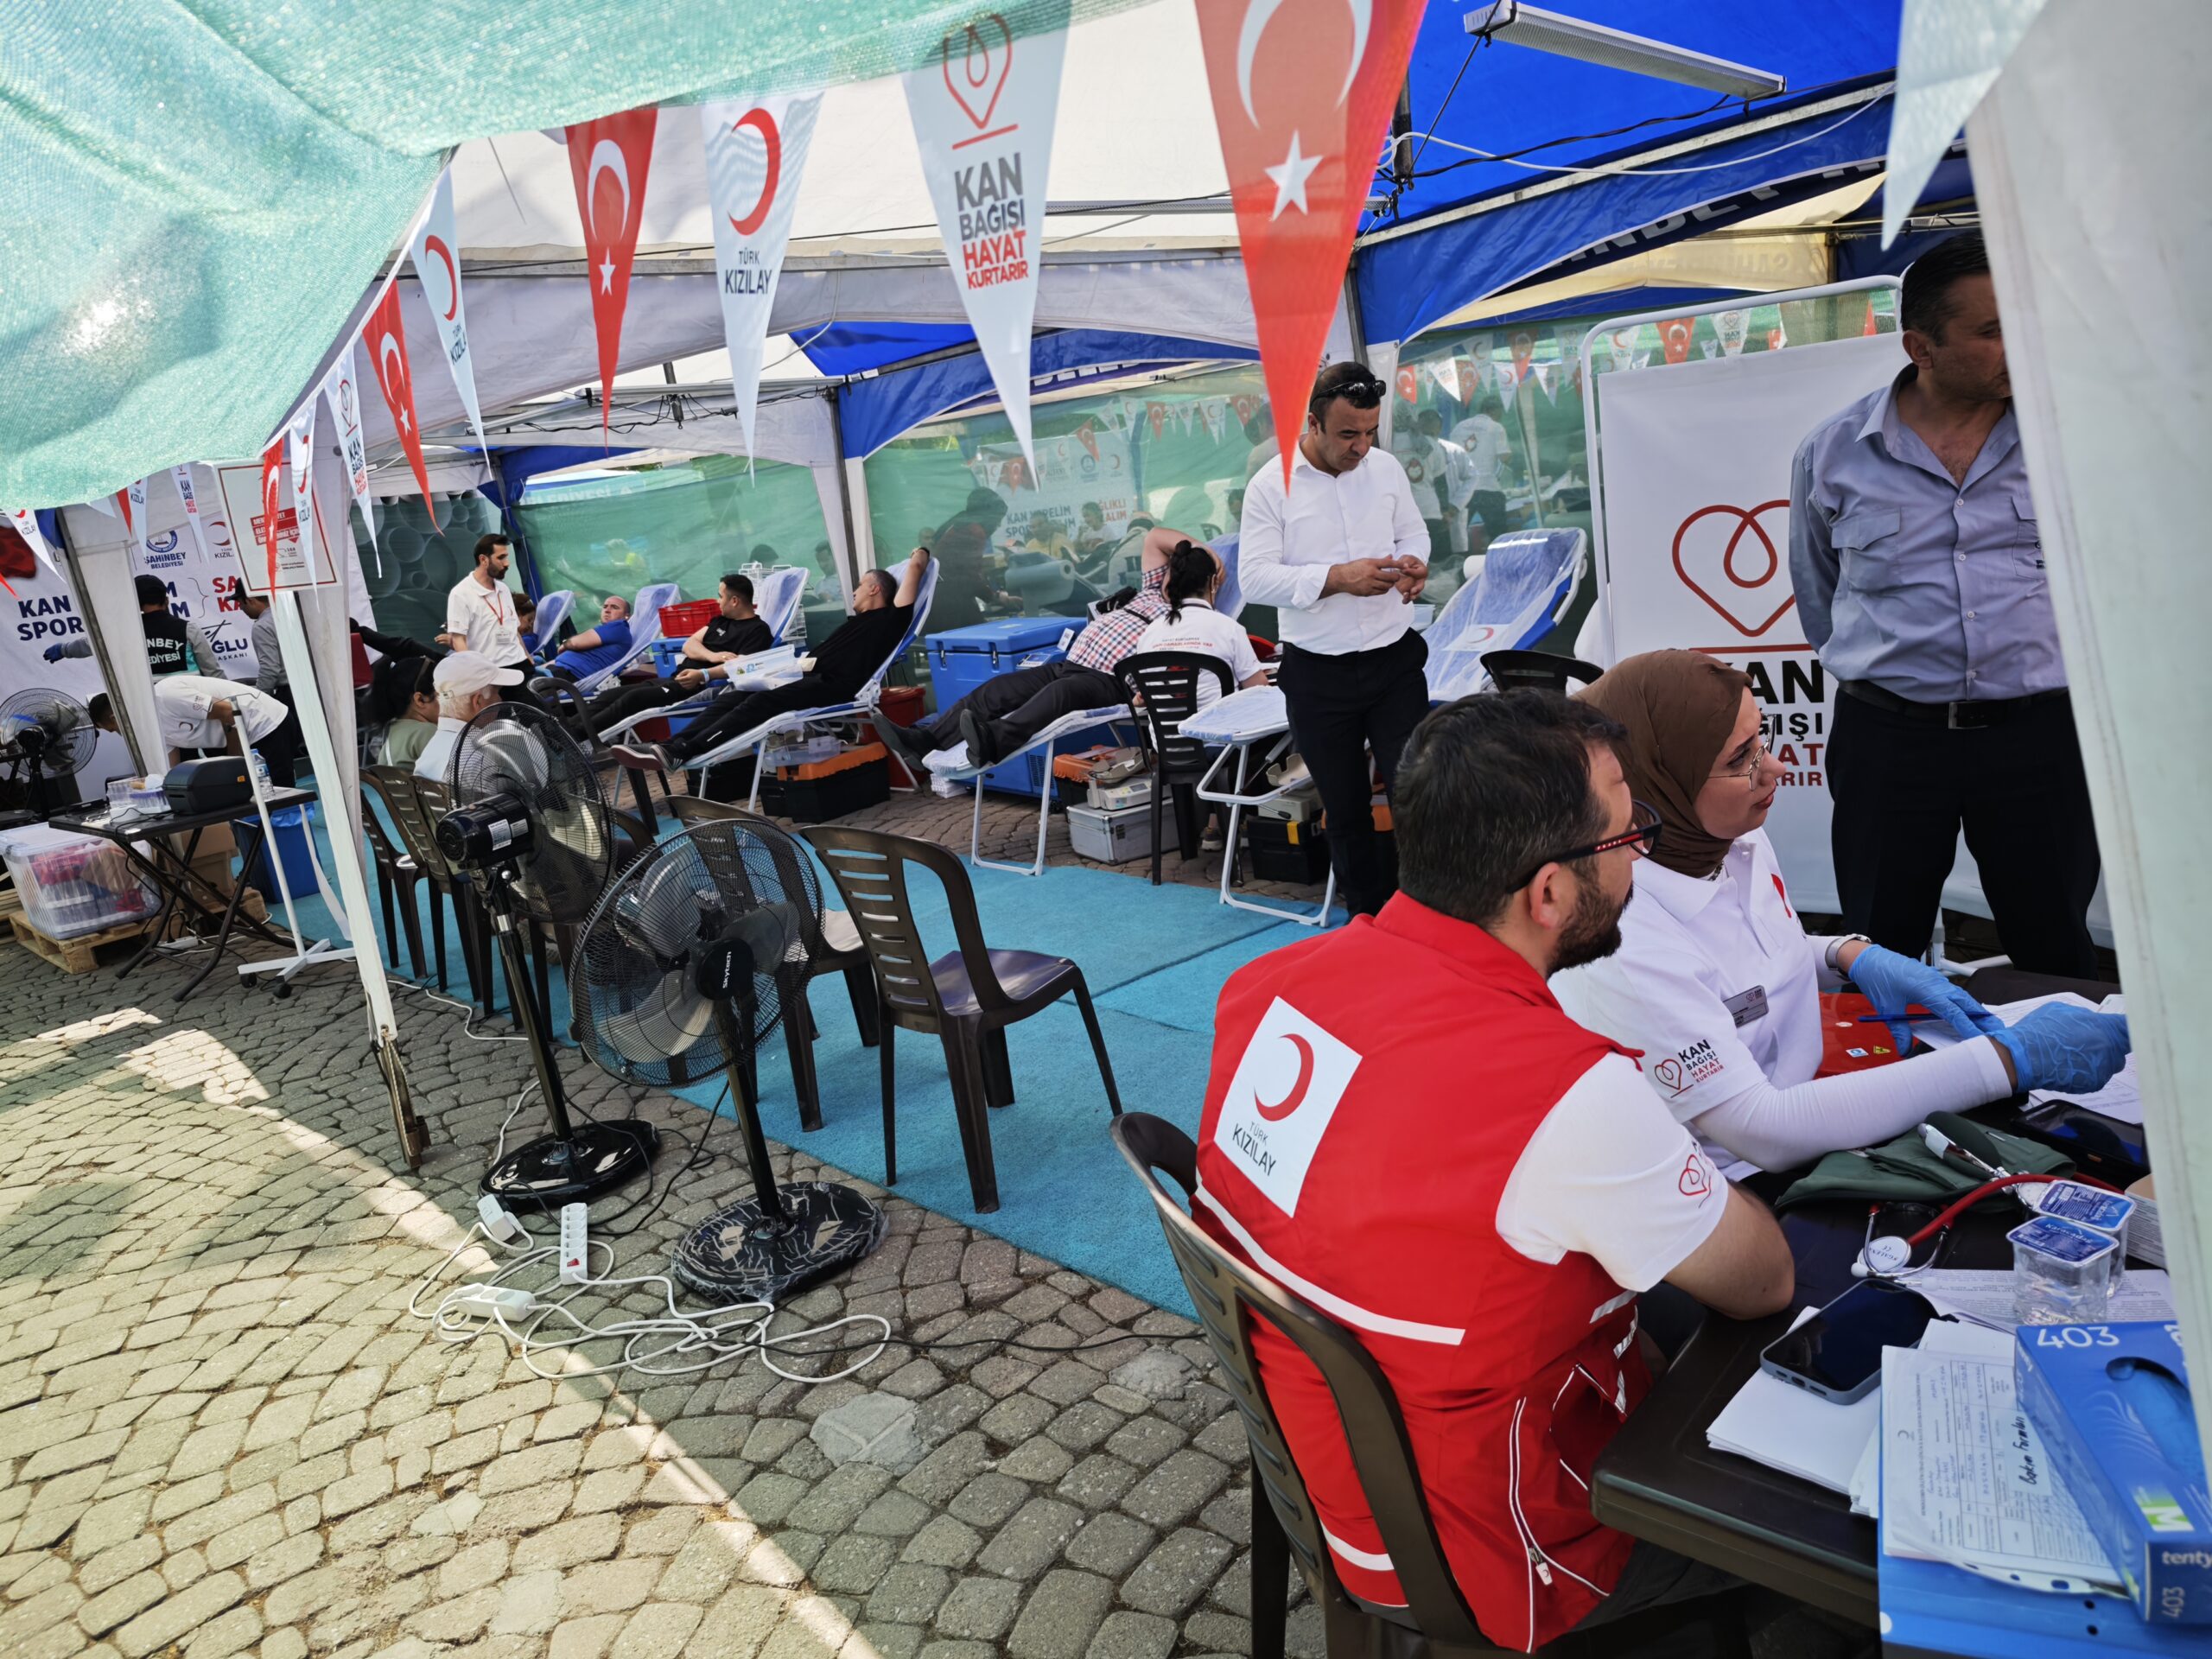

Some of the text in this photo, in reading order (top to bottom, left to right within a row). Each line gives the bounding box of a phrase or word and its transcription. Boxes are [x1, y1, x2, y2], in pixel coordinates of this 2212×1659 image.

[954, 152, 1024, 212] KAN
[958, 199, 1026, 241] BAĞIŞI
[739, 247, 760, 264] TÜRK
[963, 230, 1027, 270] HAYAT
[725, 269, 772, 294] KIZILAY
[966, 260, 1029, 290] KURTARIR
[18, 594, 72, 619] KAN
[16, 616, 85, 641] SPOR
[147, 638, 184, 651] NBEY
[212, 638, 248, 653] ĞLU
[149, 651, 181, 664] EDİYESİ
[1728, 659, 1824, 704] AN
[1758, 708, 1823, 741] ĞIŞI
[1678, 1039, 1711, 1063] KAN
[1686, 1050, 1716, 1071] BAĞIŞI
[1691, 1058, 1719, 1077] HAYAT
[1695, 1065, 1725, 1083] KURTARIR
[1251, 1121, 1268, 1146] TÜRK
[1232, 1123, 1277, 1177] KIZILAY
[2037, 1326, 2120, 1348] 403
[2162, 1586, 2185, 1618] 403
